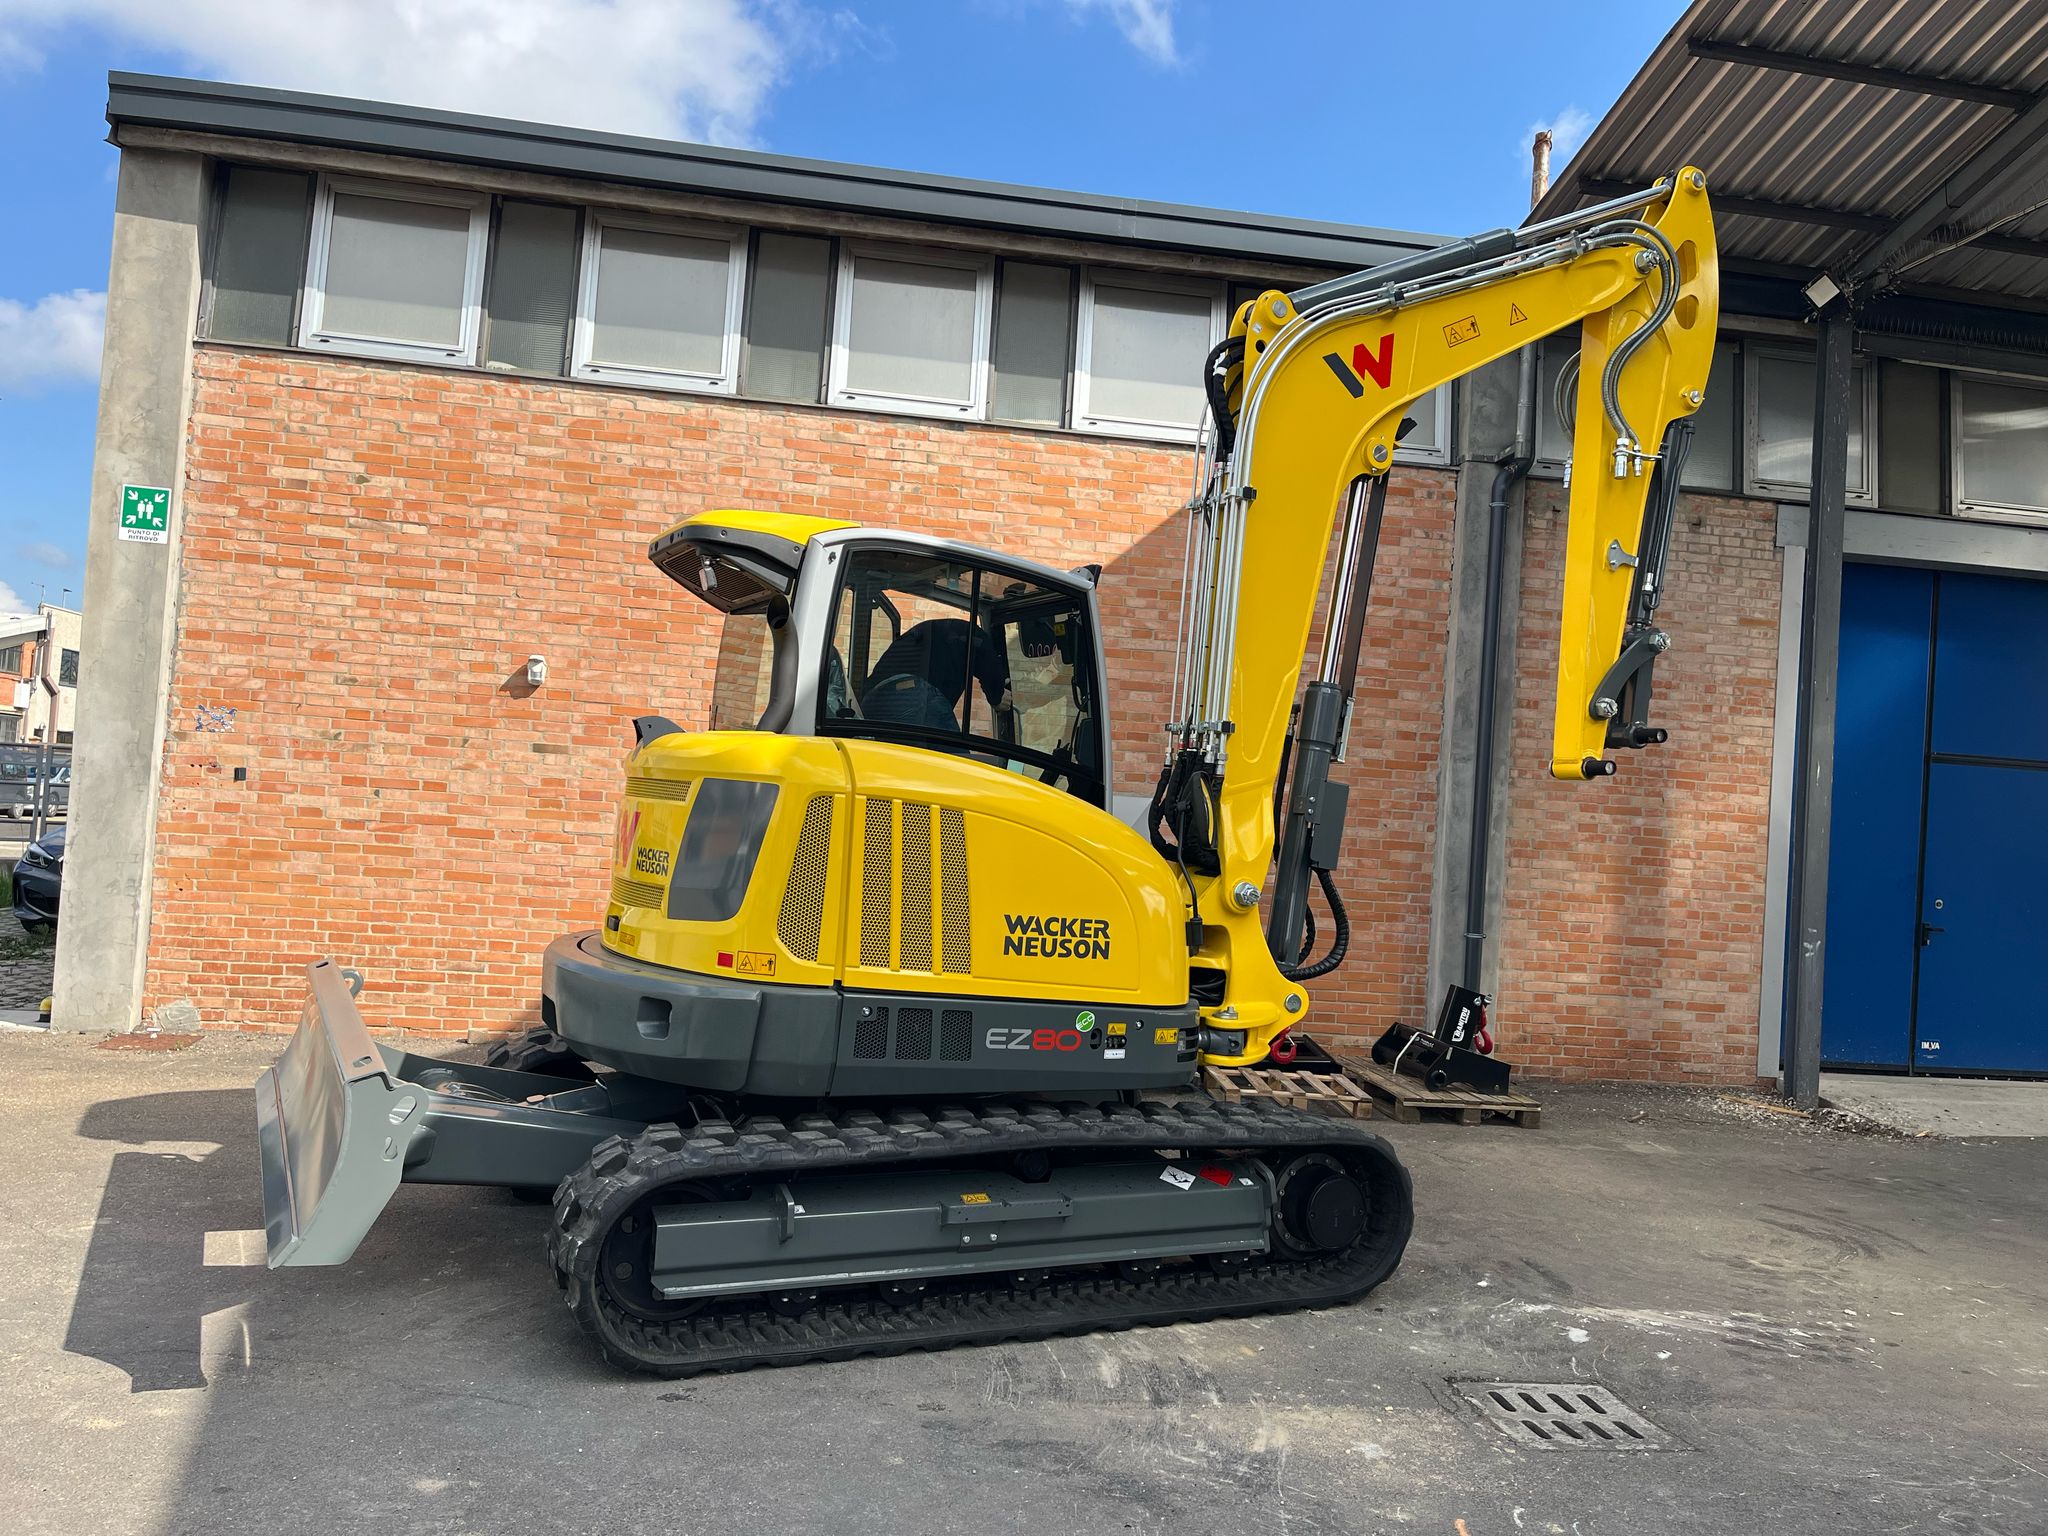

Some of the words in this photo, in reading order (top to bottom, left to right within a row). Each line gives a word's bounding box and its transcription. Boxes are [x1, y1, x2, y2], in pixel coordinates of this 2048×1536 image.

[637, 846, 670, 864] WACKER
[636, 859, 669, 877] NEUSON
[1004, 914, 1110, 939] WACKER
[1003, 936, 1110, 959] NEUSON
[1076, 1013, 1095, 1030] ECO
[985, 1028, 1081, 1050] EZ80
